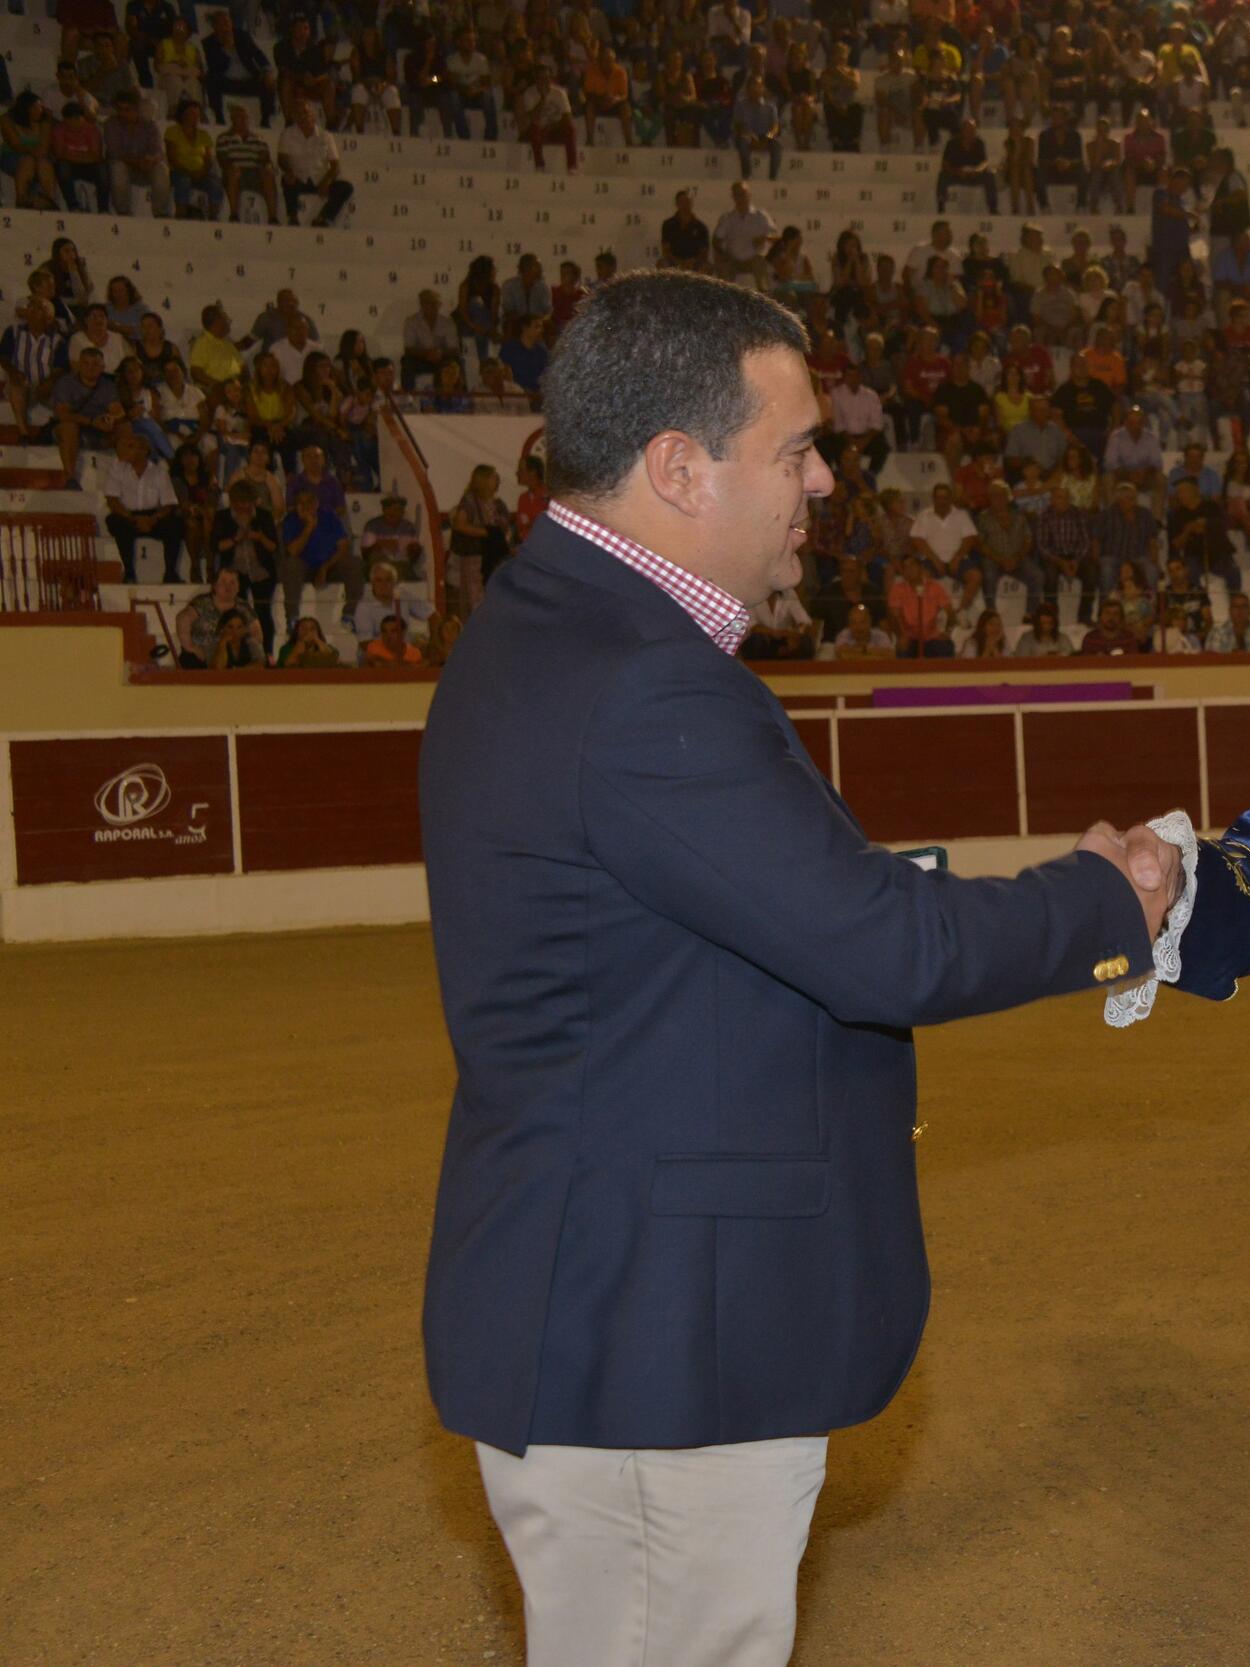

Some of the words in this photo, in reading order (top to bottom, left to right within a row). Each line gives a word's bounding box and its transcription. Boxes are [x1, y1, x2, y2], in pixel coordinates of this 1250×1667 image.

[390, 142, 402, 153] 11
[413, 174, 425, 186] 11
[393, 204, 408, 216] 10
[442, 207, 454, 218] 11
[411, 238, 426, 251] 10
[460, 240, 472, 252] 11
[141, 546, 147, 559] 1
[94, 827, 157, 842] RAPORAL
